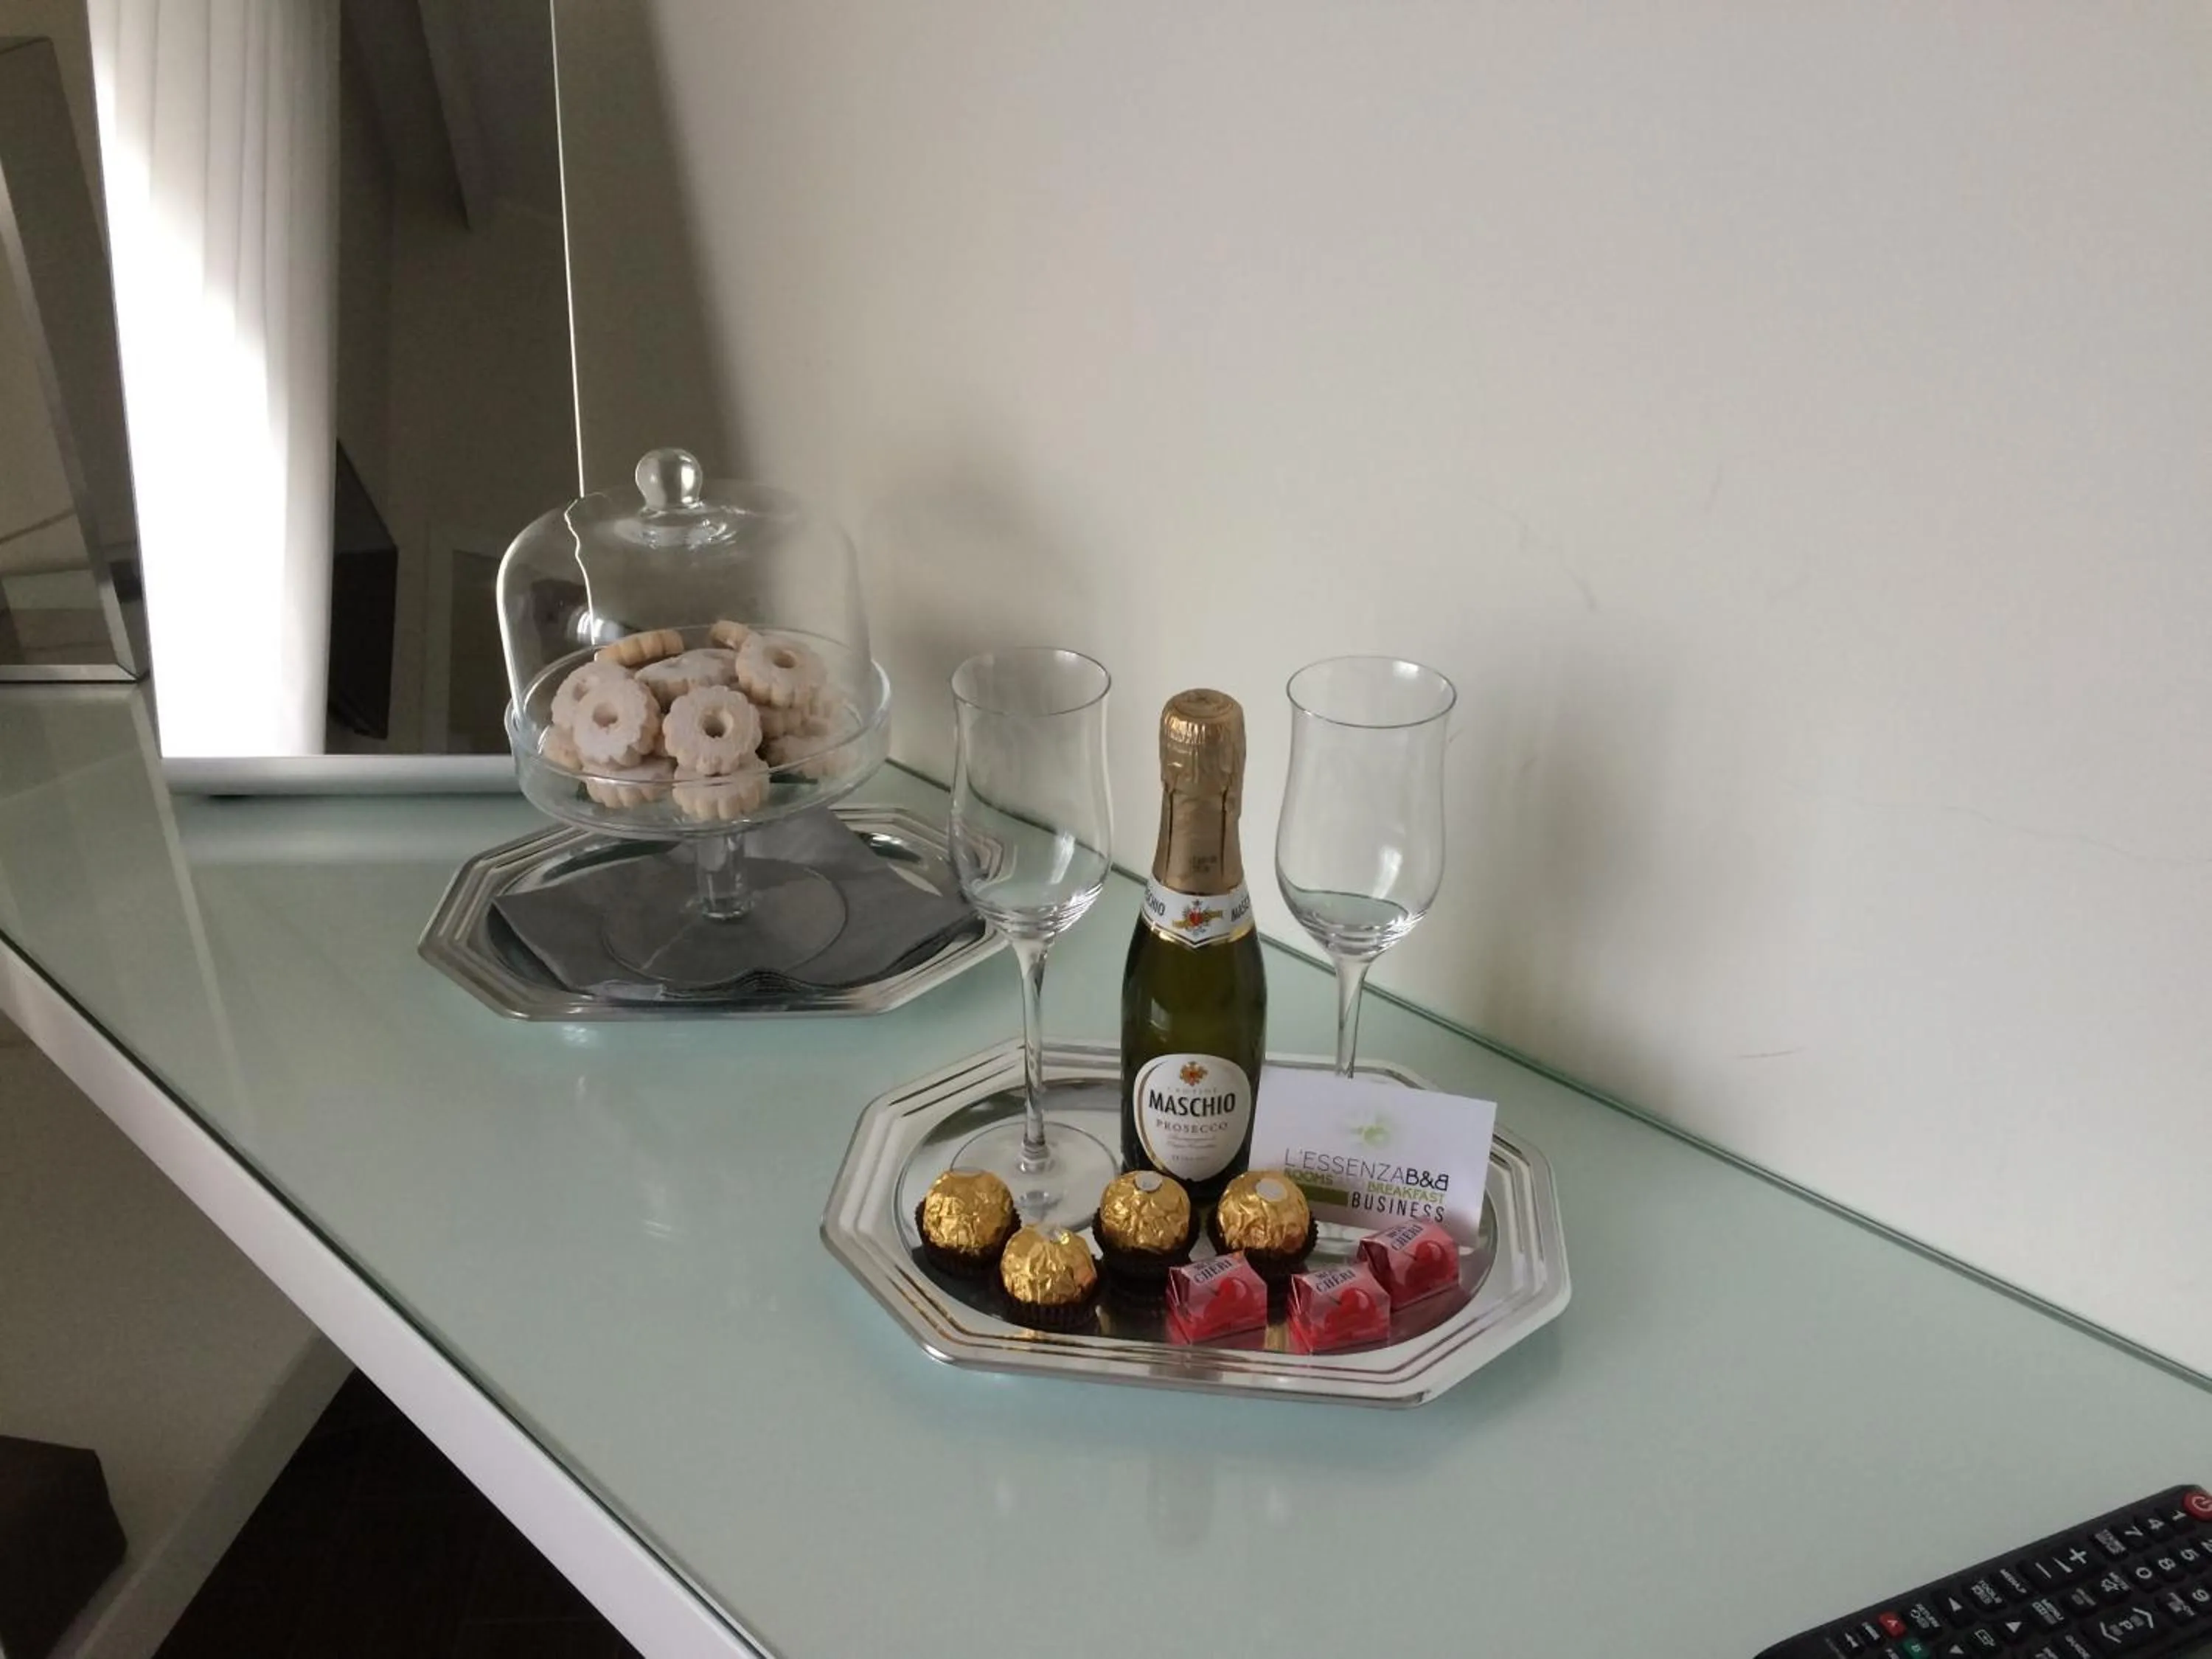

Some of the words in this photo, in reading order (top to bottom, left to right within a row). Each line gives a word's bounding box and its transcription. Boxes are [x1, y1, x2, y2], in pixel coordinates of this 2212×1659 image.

[1149, 1088, 1237, 1117] MASCHIO
[1155, 1119, 1229, 1134] PROSECCO
[1368, 1183, 1446, 1205] BREAKFAST
[1351, 1191, 1445, 1223] BUSINESS
[2180, 1548, 2200, 1561] 5
[2157, 1557, 2176, 1571] 8
[2192, 1588, 2210, 1602] 9
